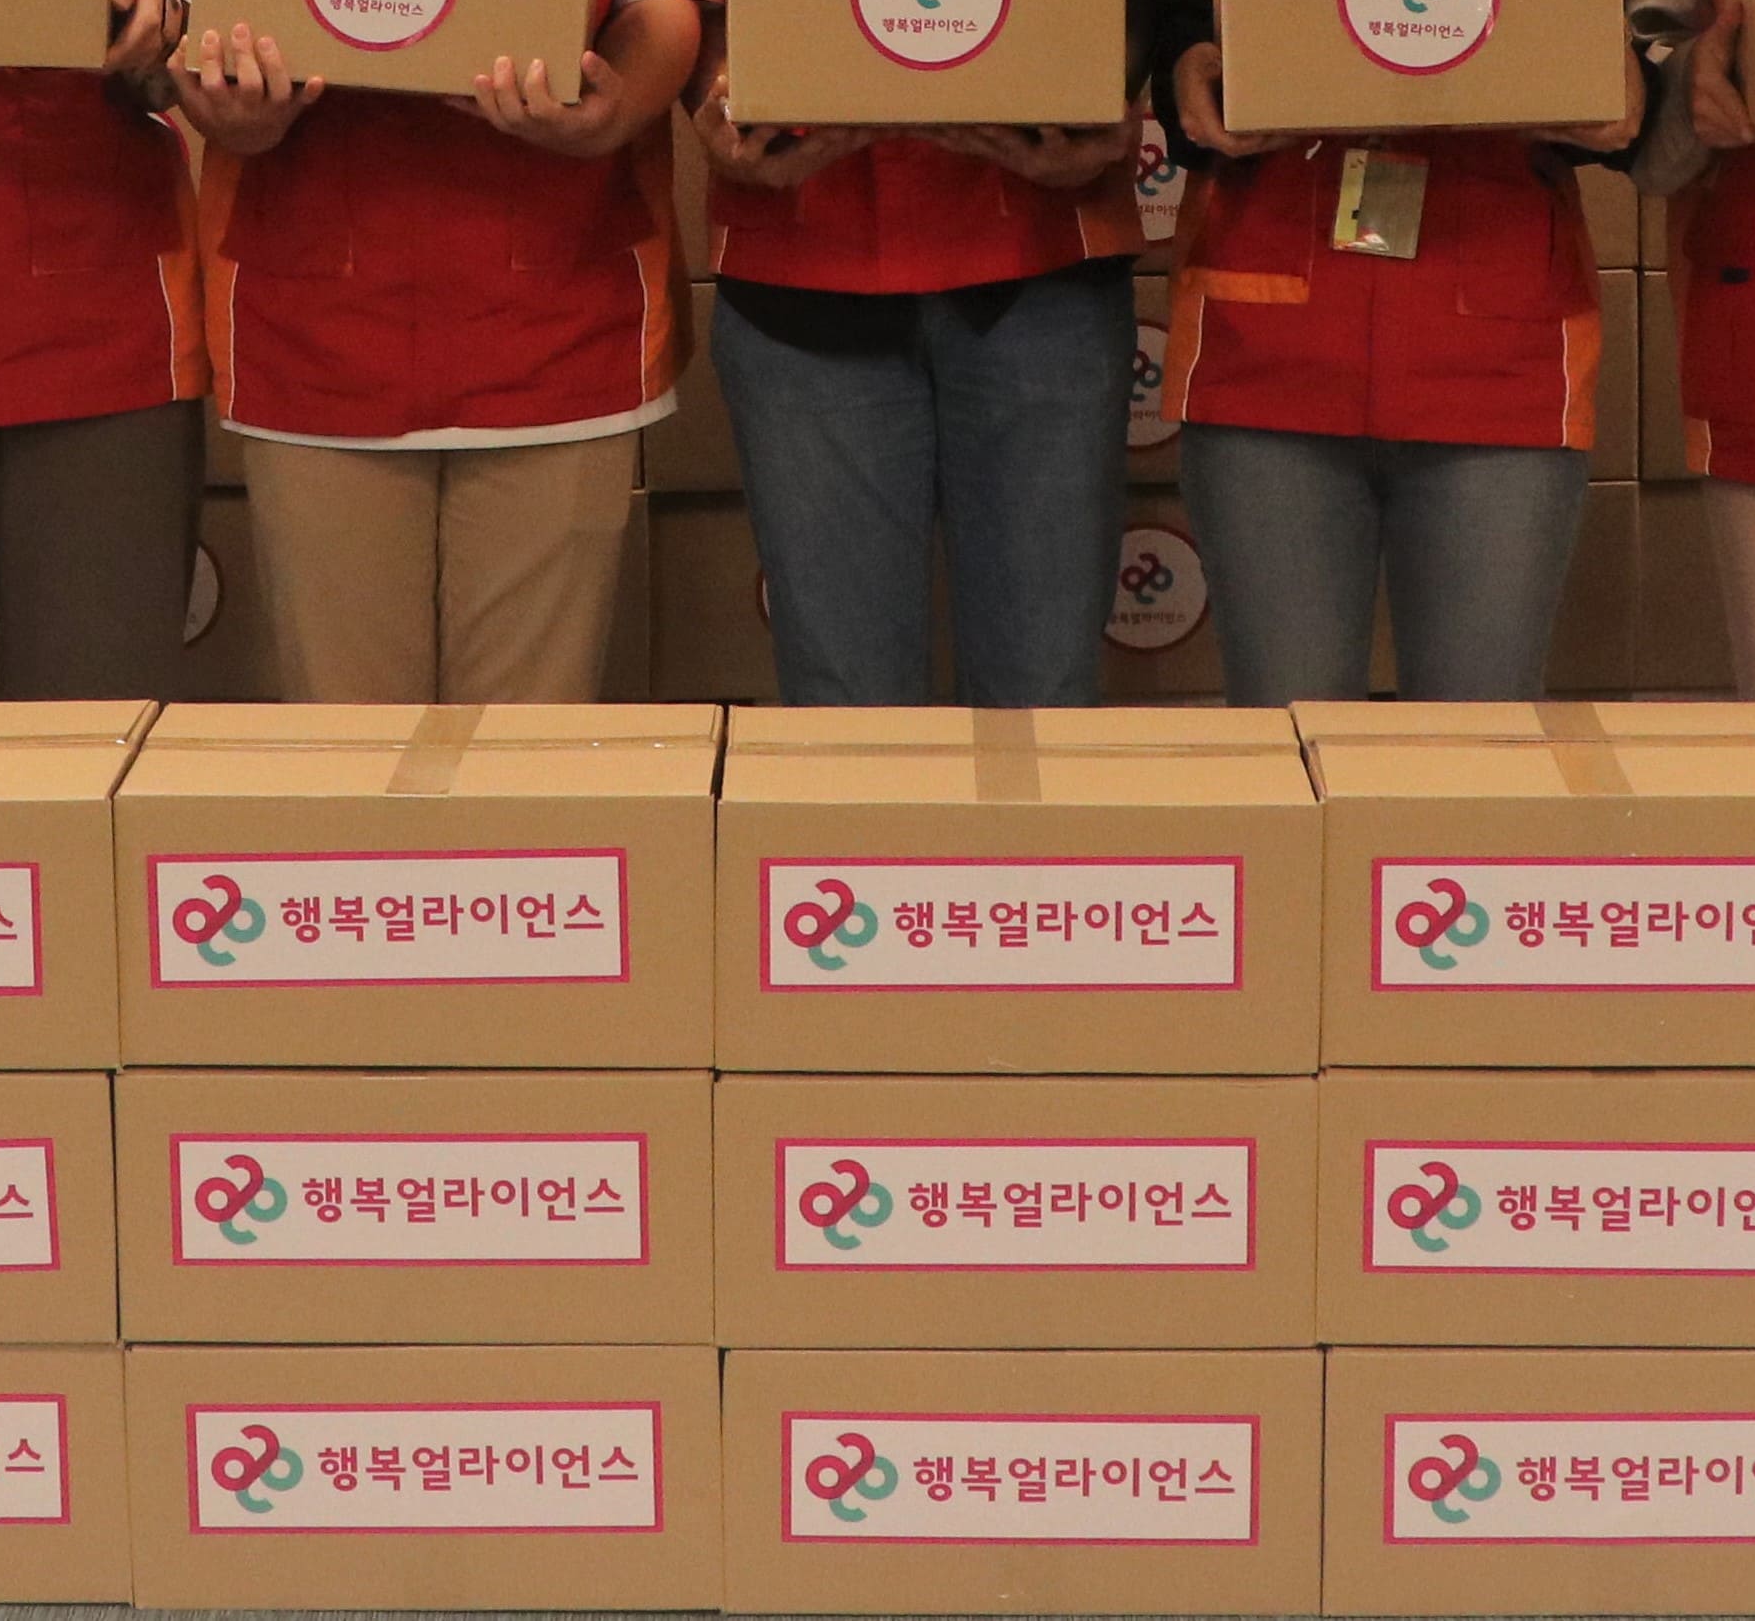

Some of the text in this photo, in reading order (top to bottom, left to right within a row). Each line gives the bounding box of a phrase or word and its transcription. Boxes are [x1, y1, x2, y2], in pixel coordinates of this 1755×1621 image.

[883, 19, 976, 33] 행복얼라이언스
[1369, 21, 1464, 39] 행복얼라이언스
[280, 894, 605, 945] 행복얼라이언스
[894, 901, 1219, 949] 행복얼라이언스
[302, 1177, 625, 1224] 행복얼라이언스
[908, 1182, 1232, 1229] 행복얼라이언스
[318, 1445, 638, 1493] 행복얼라이언스
[914, 1457, 1235, 1504] 행복얼라이언스
